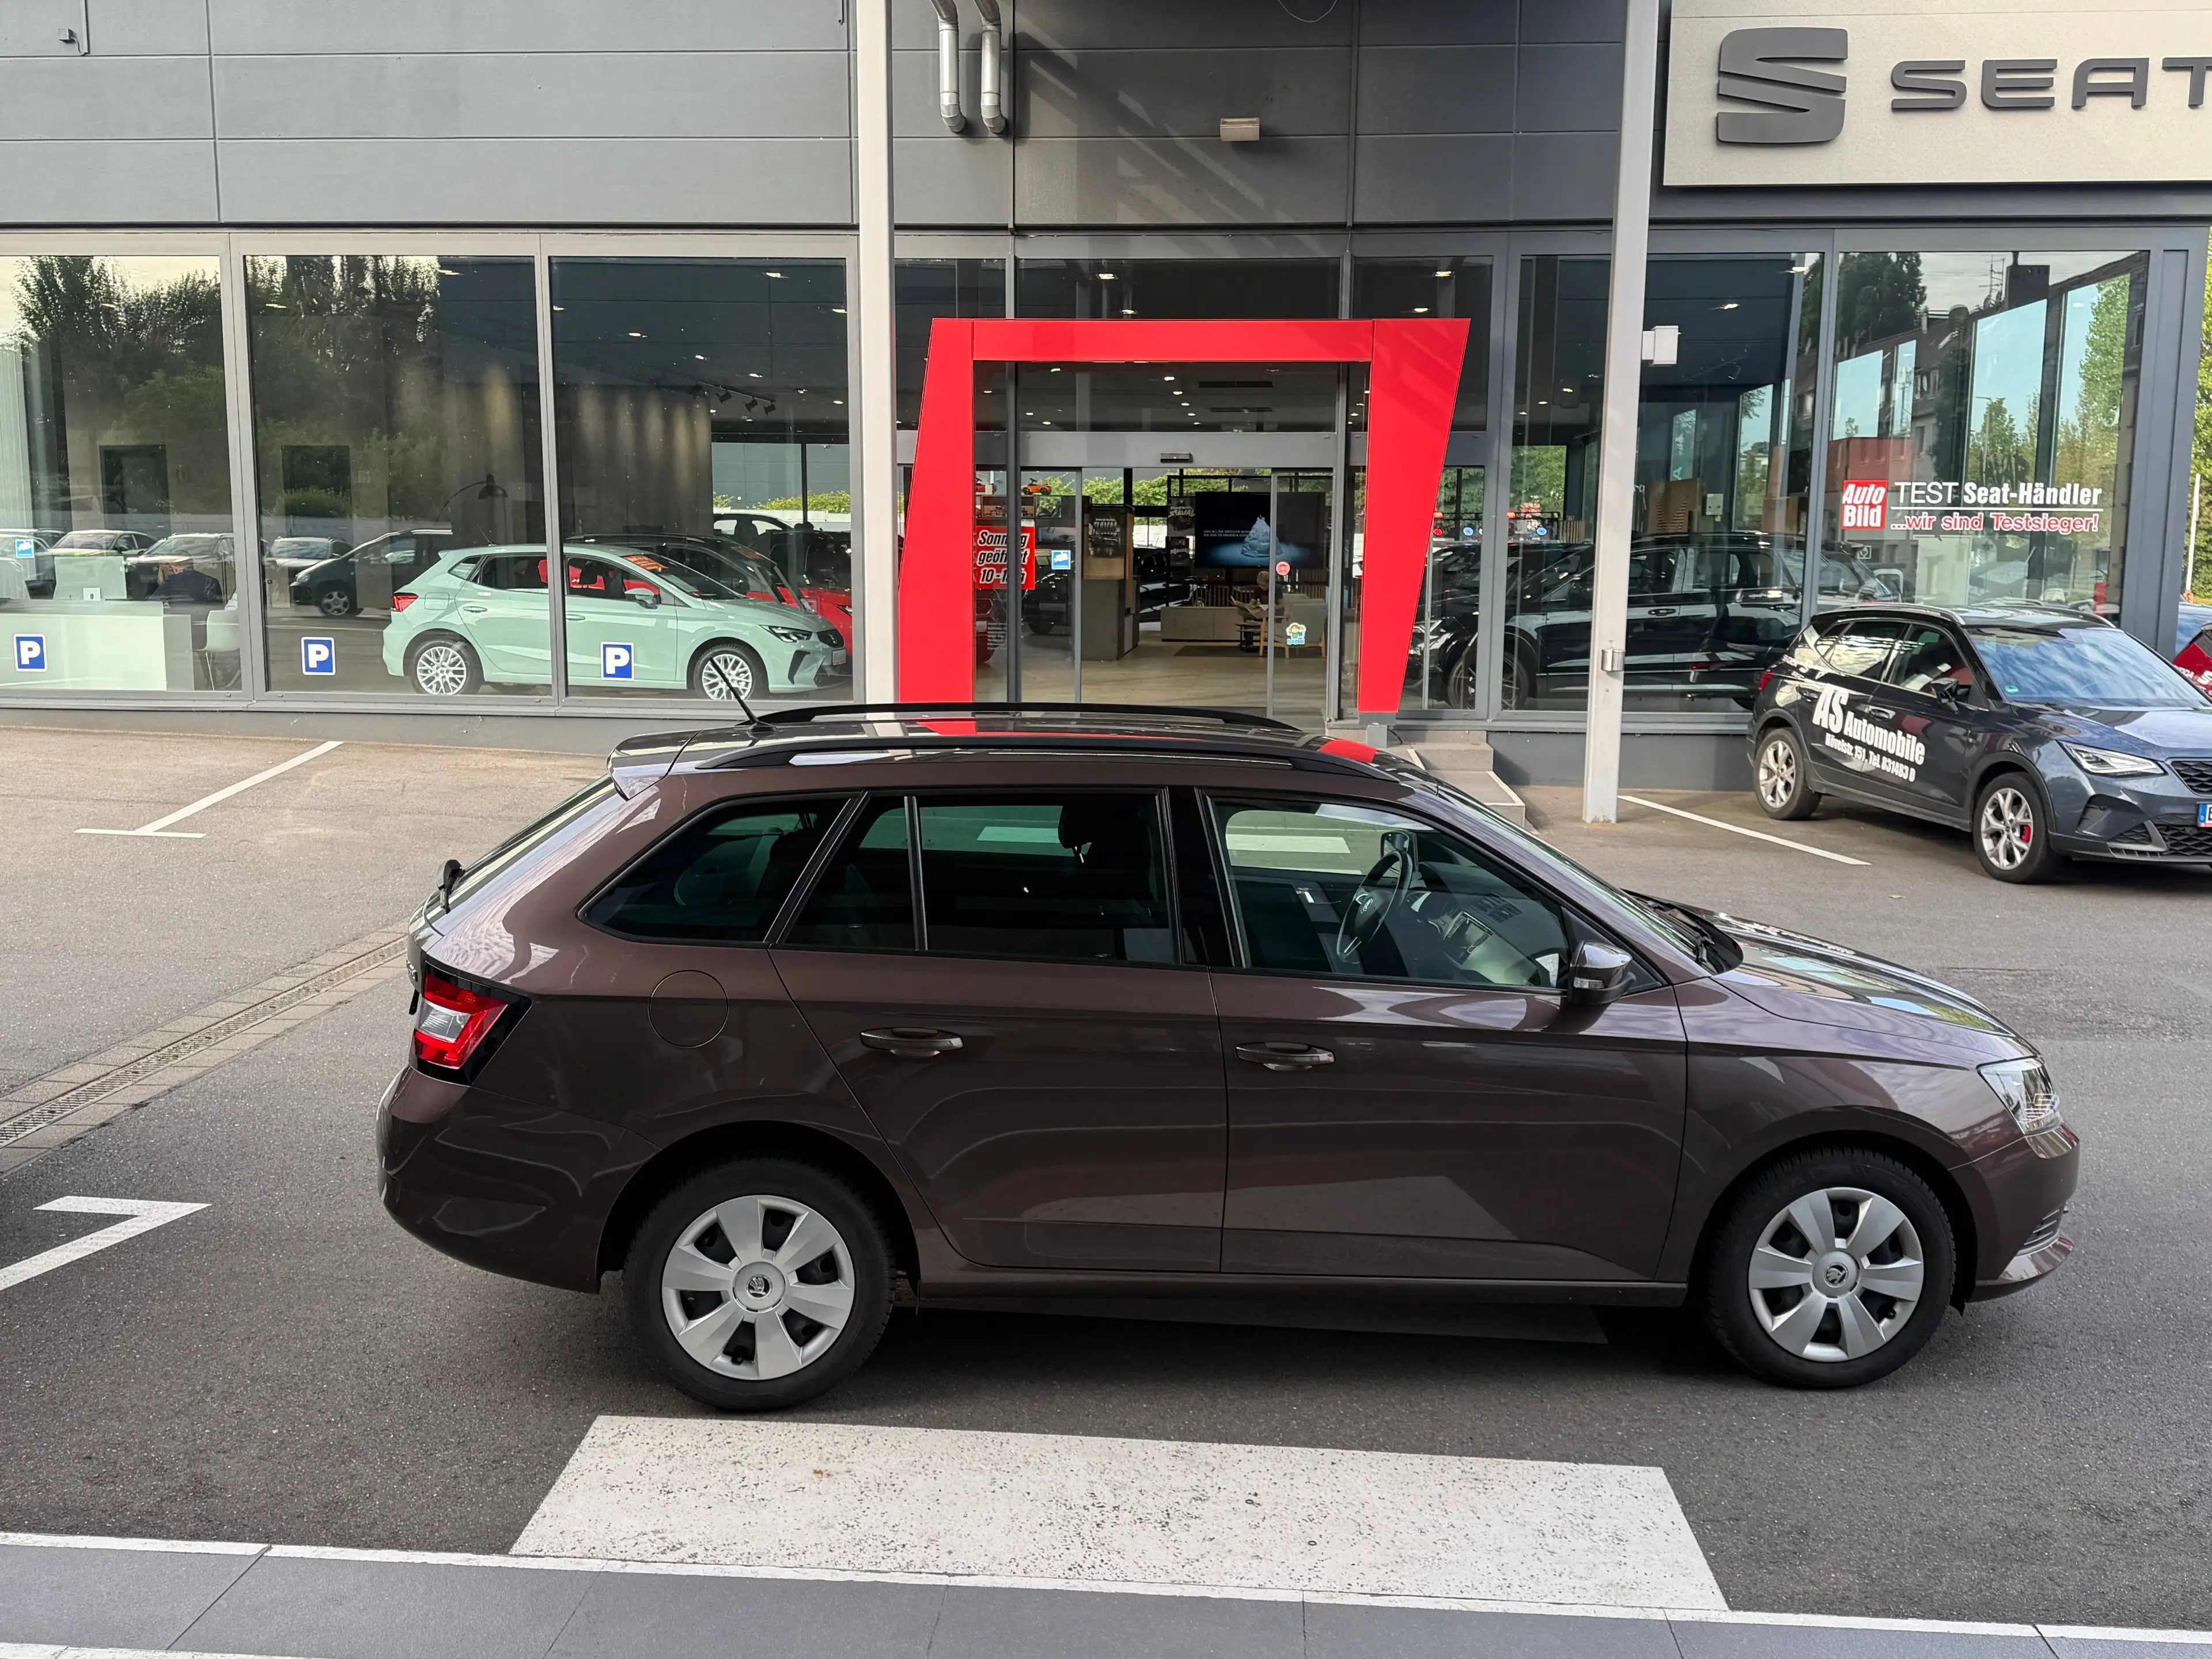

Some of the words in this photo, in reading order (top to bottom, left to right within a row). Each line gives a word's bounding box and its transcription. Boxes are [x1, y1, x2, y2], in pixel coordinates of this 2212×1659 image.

[1891, 56, 2212, 110] SEAT
[1843, 483, 1885, 505] Auto
[1895, 482, 1959, 504] TEST
[1963, 482, 2103, 505] Seat-Händler
[1843, 505, 1883, 527] Bild
[1890, 513, 1936, 531] ...wir
[1941, 512, 1984, 531] sind
[1991, 513, 2099, 535] Testsieger!
[978, 531, 1029, 549] Sonng
[20, 641, 41, 665] P
[308, 643, 329, 668] P
[605, 647, 630, 675] P
[1812, 683, 1849, 733] AS
[1843, 711, 1926, 766] Automobile
